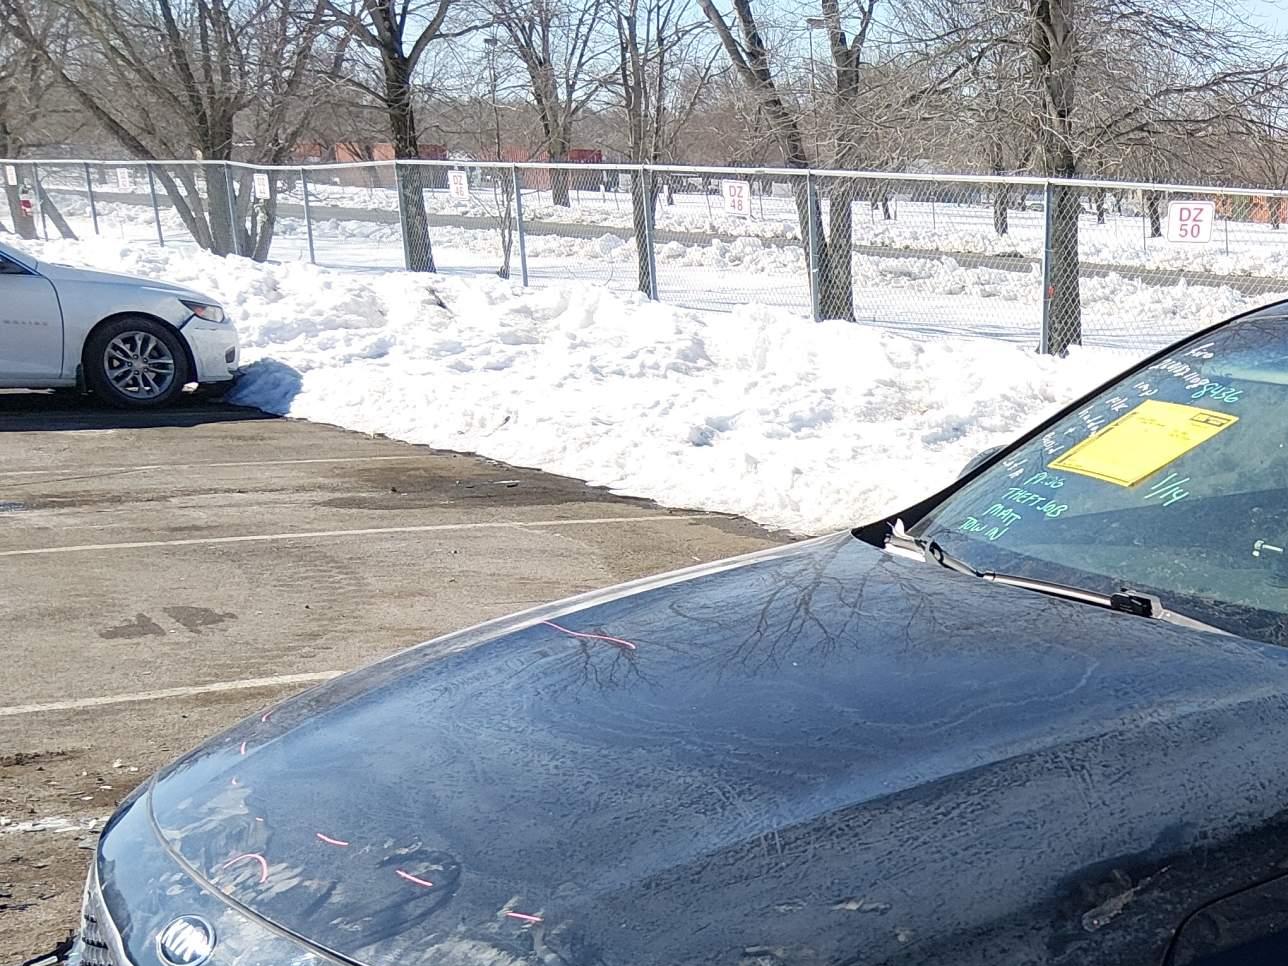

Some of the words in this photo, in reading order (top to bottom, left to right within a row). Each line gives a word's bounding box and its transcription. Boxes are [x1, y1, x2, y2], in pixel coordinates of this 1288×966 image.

[729, 184, 744, 198] DZ
[730, 199, 744, 211] 48
[1178, 207, 1204, 222] DZ
[1178, 223, 1201, 239] 50
[1191, 382, 1244, 403] 8436
[1001, 487, 1047, 507] THEFT
[1036, 500, 1068, 518] JOB
